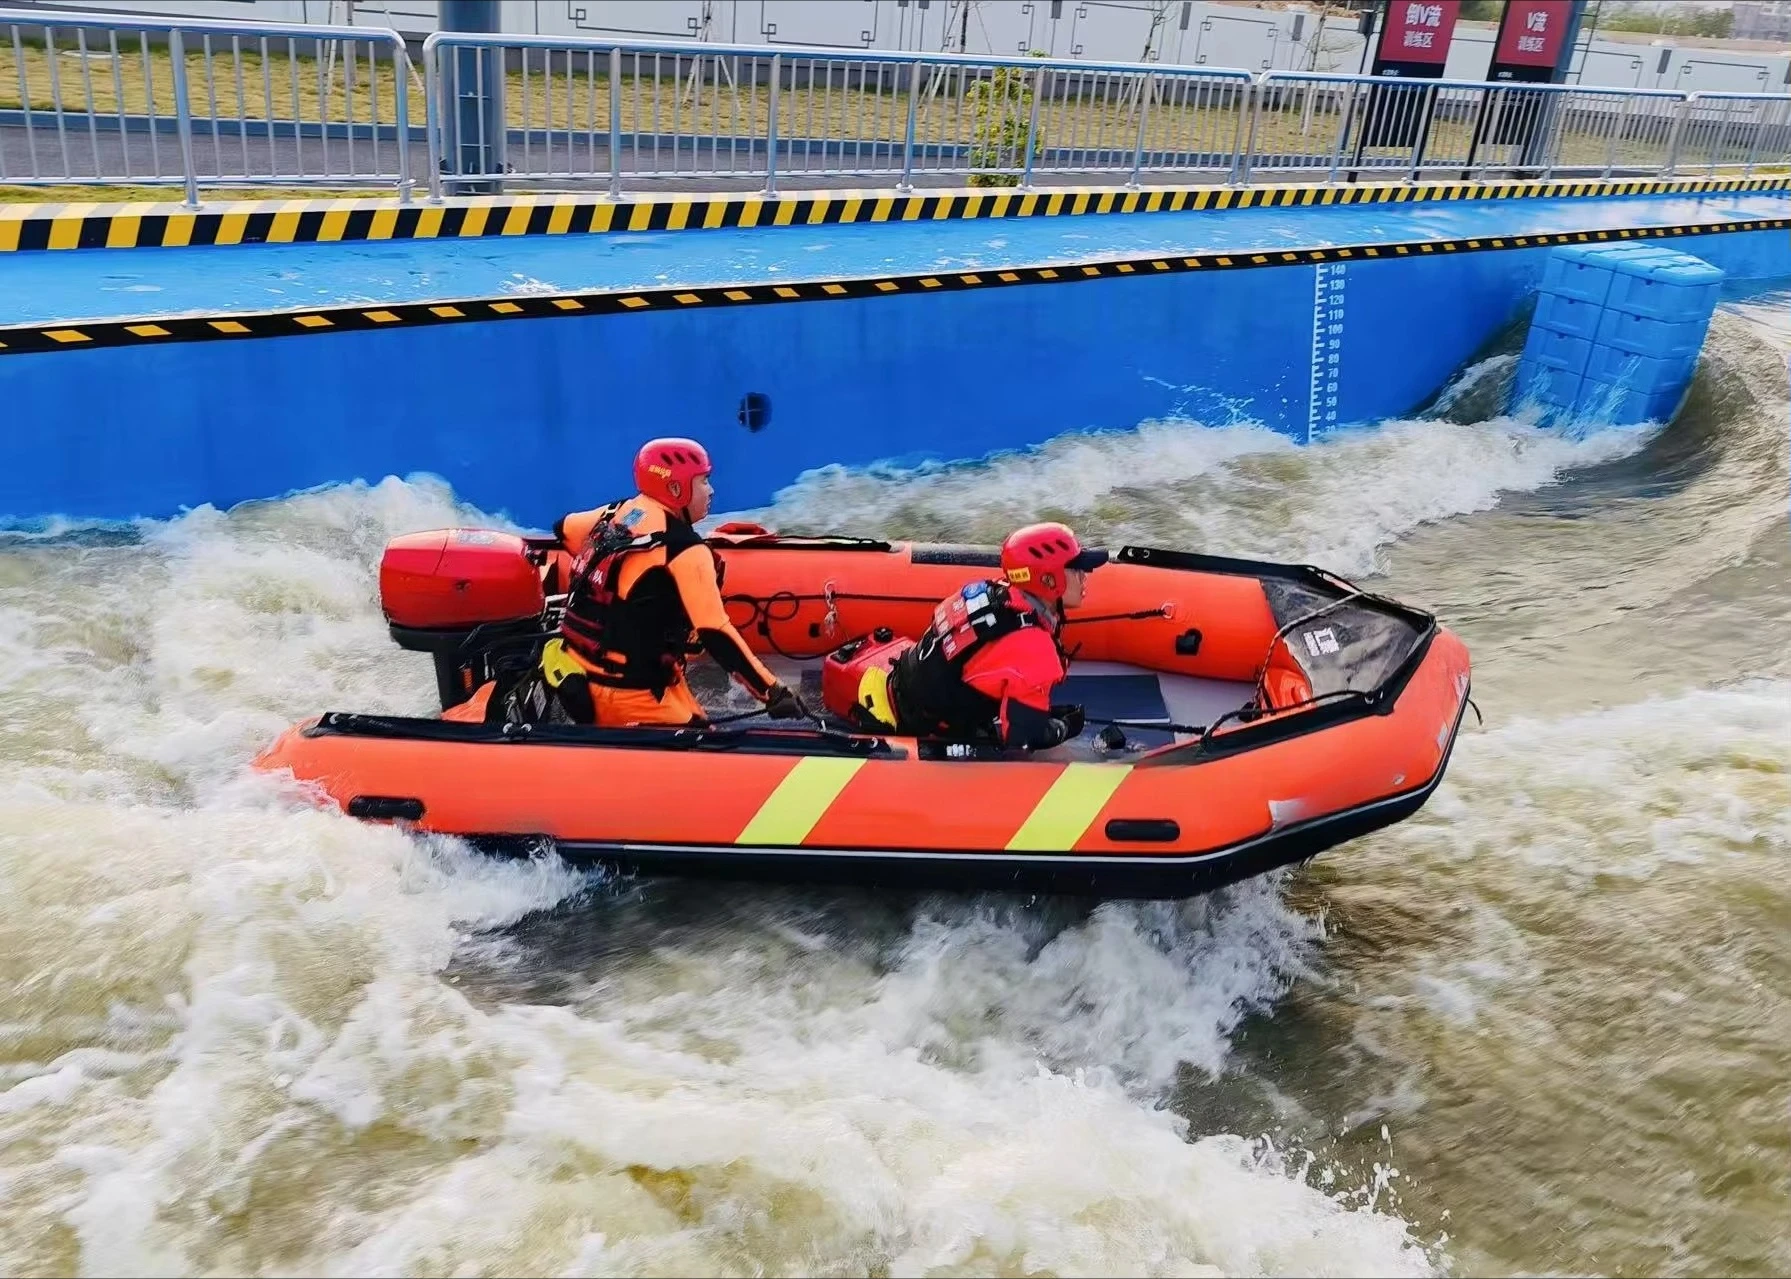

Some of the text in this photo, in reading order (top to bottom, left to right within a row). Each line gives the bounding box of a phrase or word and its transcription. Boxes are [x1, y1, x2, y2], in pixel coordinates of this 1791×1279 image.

[1330, 264, 1346, 275] 140
[1330, 279, 1345, 291] 130
[1329, 294, 1345, 305] 120
[1328, 309, 1344, 321] 110
[1328, 323, 1343, 335] 100
[1328, 339, 1340, 349] 90
[1328, 353, 1339, 364] 80
[1328, 368, 1339, 378] 70
[1327, 382, 1338, 393] 60
[1326, 396, 1337, 408] 50
[1325, 411, 1337, 422] 40
